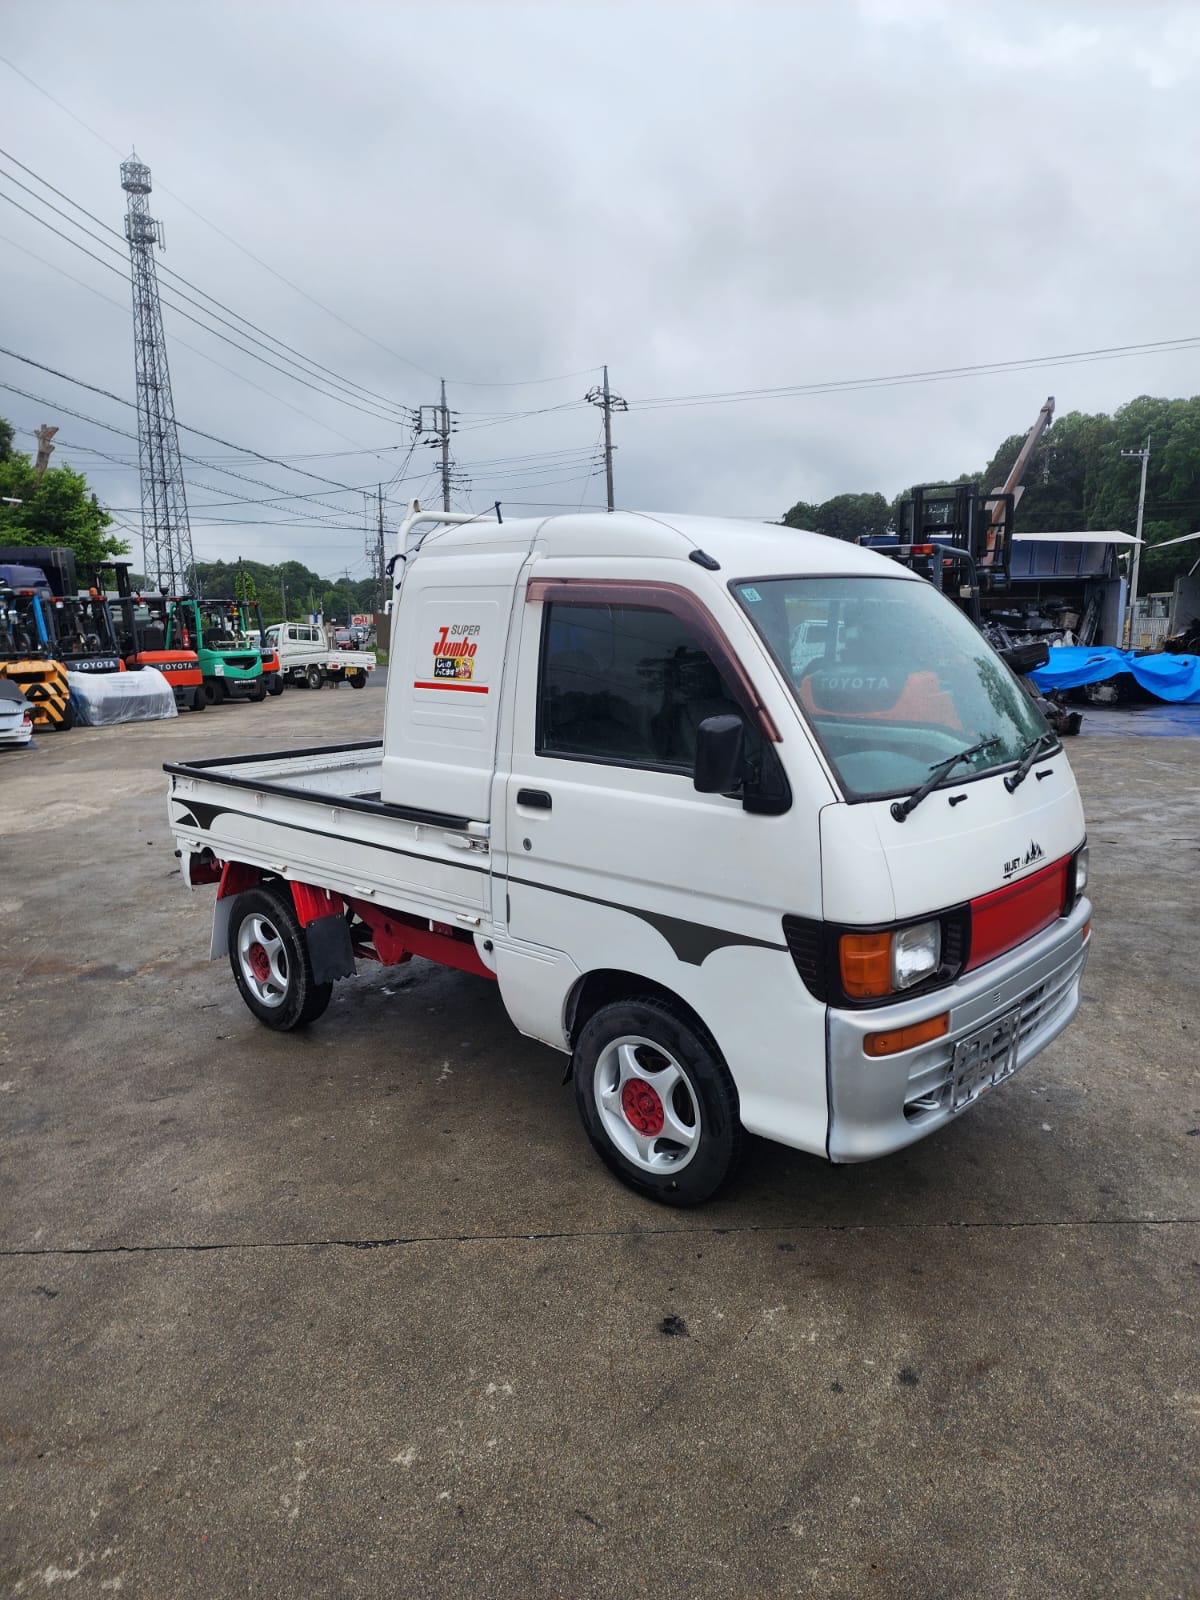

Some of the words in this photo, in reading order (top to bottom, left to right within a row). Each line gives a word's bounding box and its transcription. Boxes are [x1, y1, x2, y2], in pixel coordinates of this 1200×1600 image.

[451, 624, 480, 636] SUPER
[433, 626, 478, 658] Jumbo
[75, 661, 116, 670] TOYOTA
[821, 677, 890, 689] TOYOTA
[1004, 857, 1021, 873] HIJET
